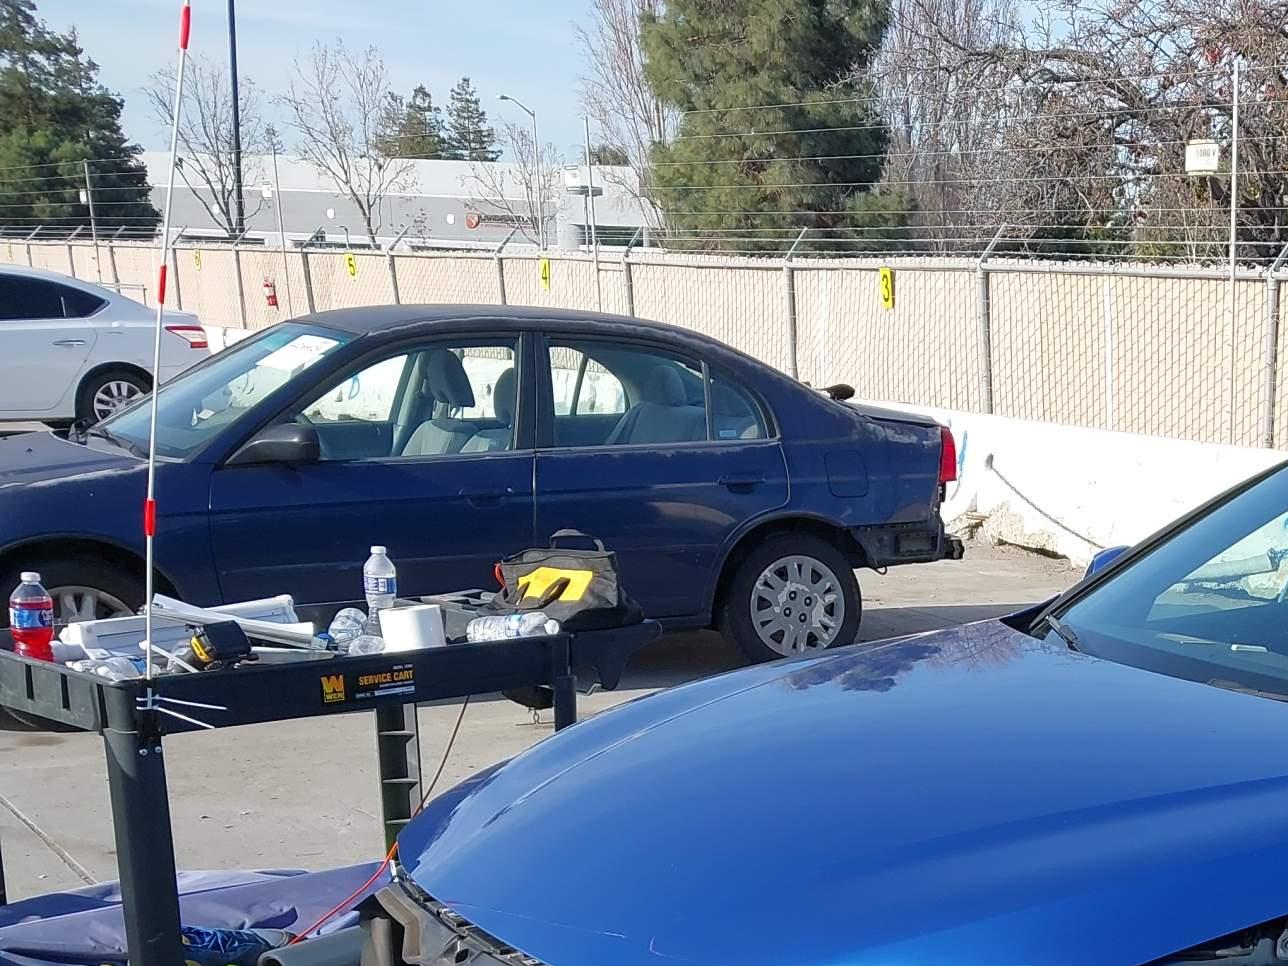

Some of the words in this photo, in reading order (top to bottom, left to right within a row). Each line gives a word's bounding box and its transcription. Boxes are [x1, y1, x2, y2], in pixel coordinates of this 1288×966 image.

[348, 257, 356, 276] 5
[541, 260, 548, 285] 4
[882, 274, 890, 302] 3
[358, 672, 393, 686] SERVICE
[393, 670, 414, 681] CART
